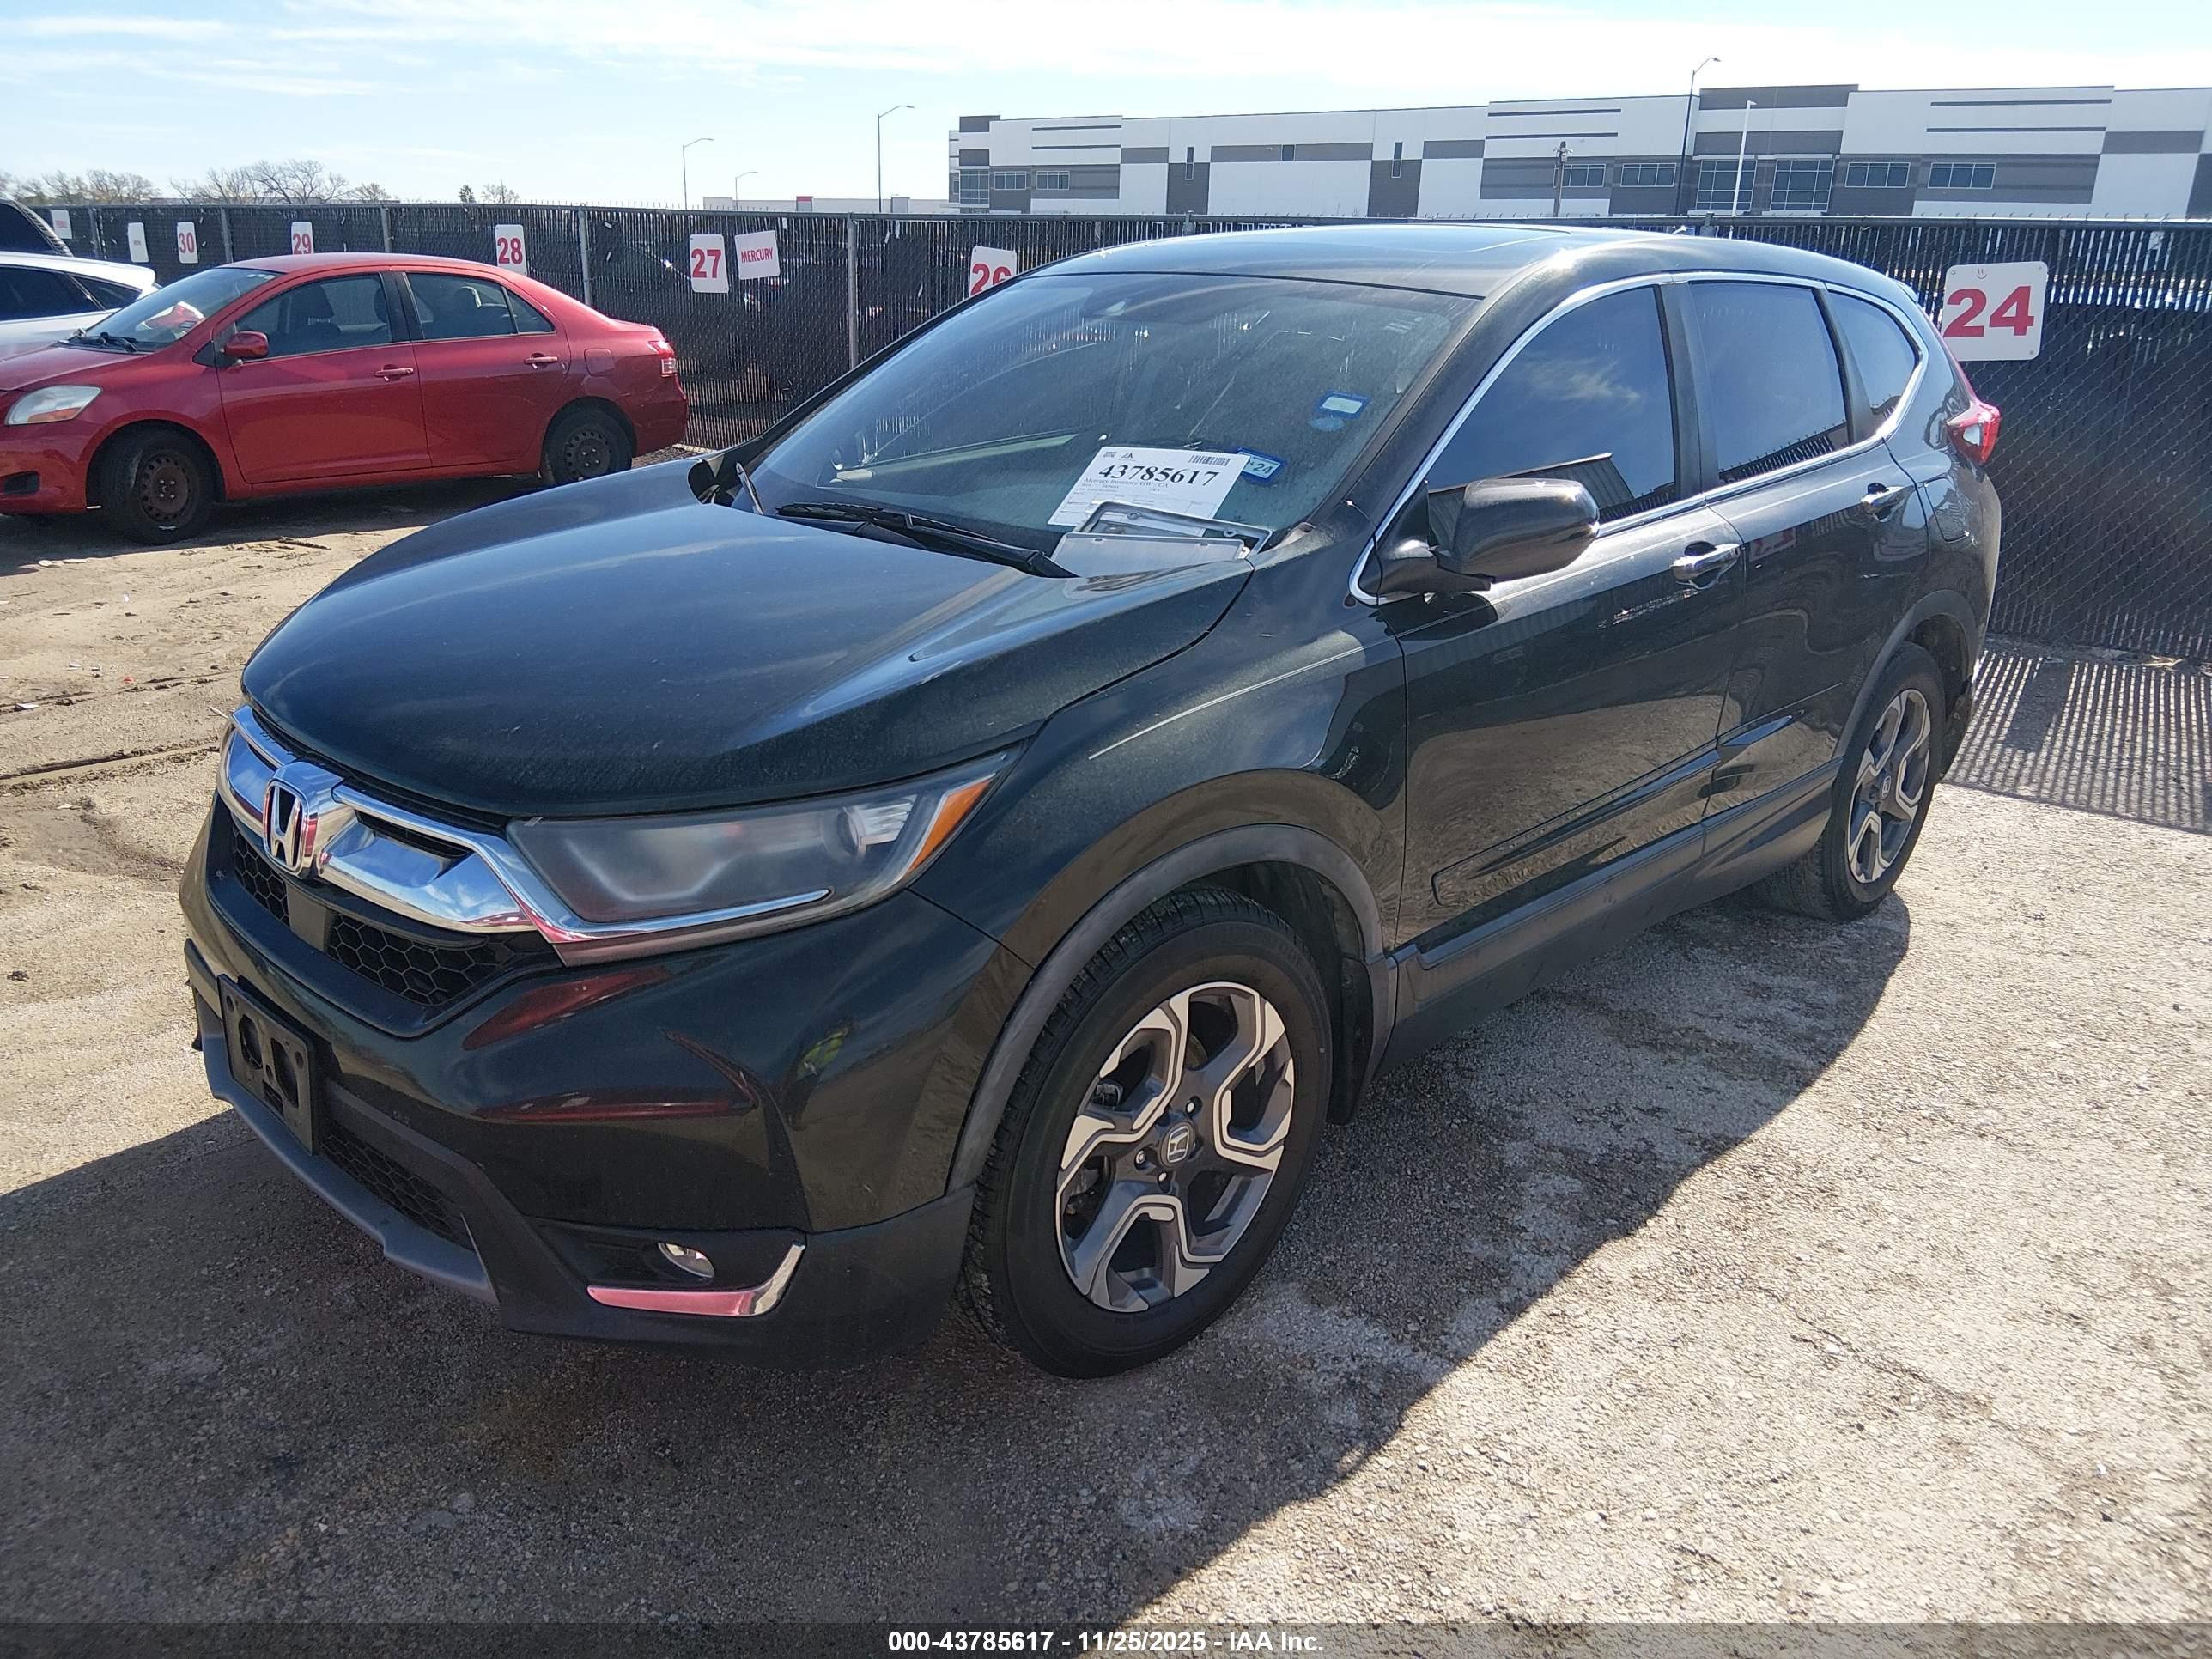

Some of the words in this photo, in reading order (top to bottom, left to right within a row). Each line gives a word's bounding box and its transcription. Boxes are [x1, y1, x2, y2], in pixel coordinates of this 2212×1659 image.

[178, 232, 195, 253] 30
[292, 233, 312, 254] 29
[497, 237, 523, 264] 28
[691, 248, 722, 278] 27
[741, 246, 774, 263] MERCURY
[1943, 285, 2035, 338] 24
[1098, 464, 1220, 486] 43785617
[1253, 463, 1273, 474] 24
